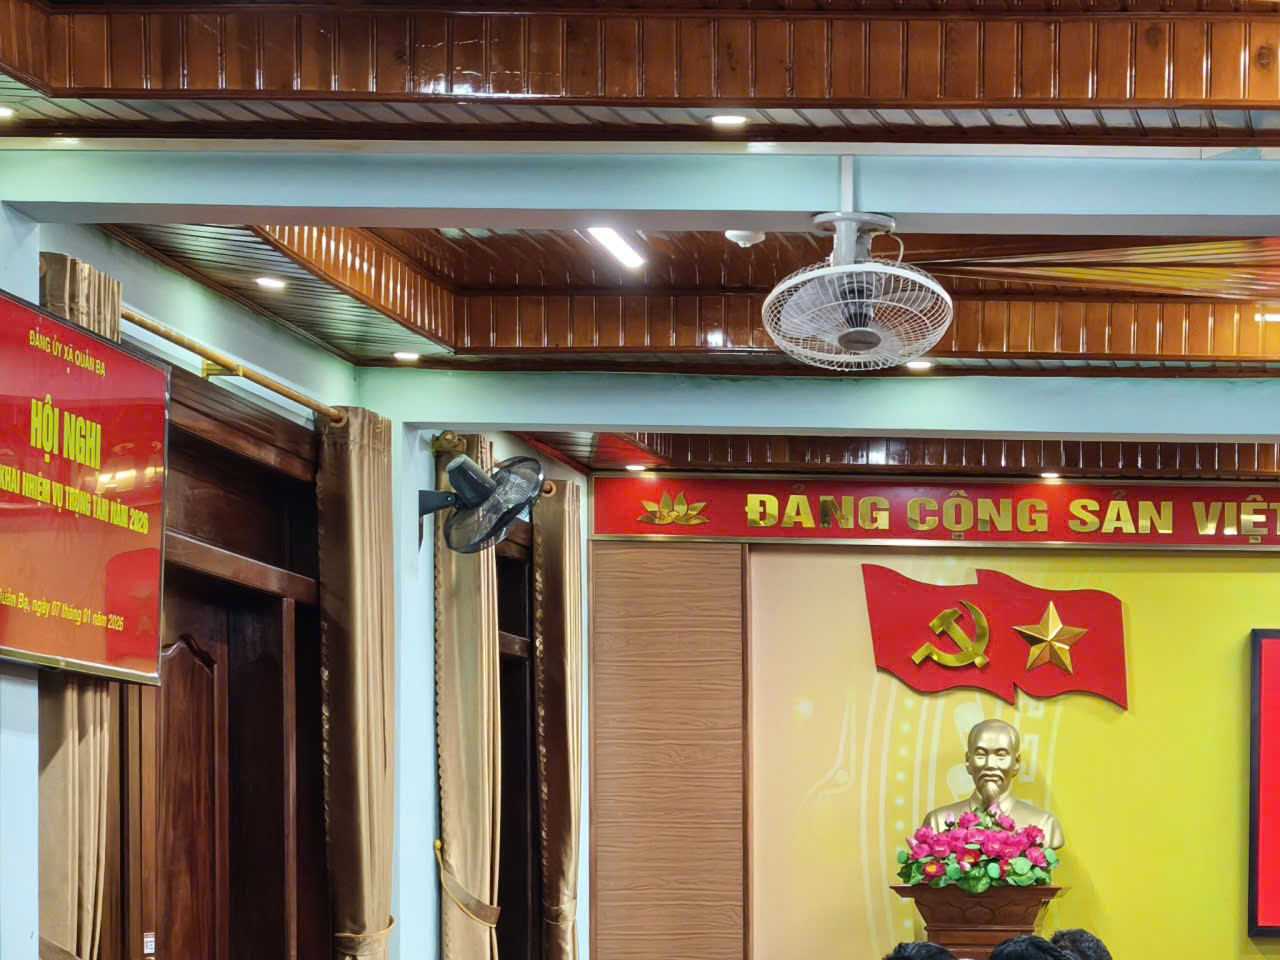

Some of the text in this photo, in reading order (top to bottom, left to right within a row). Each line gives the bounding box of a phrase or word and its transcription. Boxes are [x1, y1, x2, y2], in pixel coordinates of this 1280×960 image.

[30, 326, 51, 353] ĐẢNG
[53, 334, 63, 358] ỦY
[64, 343, 74, 364] XÃ
[75, 348, 95, 372] QUẢN
[31, 393, 60, 464] HỘI
[22, 470, 51, 507] NHIỆM
[52, 480, 64, 513] VỤ
[65, 485, 91, 518] TRỌNG
[129, 506, 149, 536] 2026
[745, 482, 890, 531] ĐẢNG
[907, 489, 1049, 540] CỘNG
[1068, 488, 1174, 536] SẢN
[51, 600, 61, 616] 07
